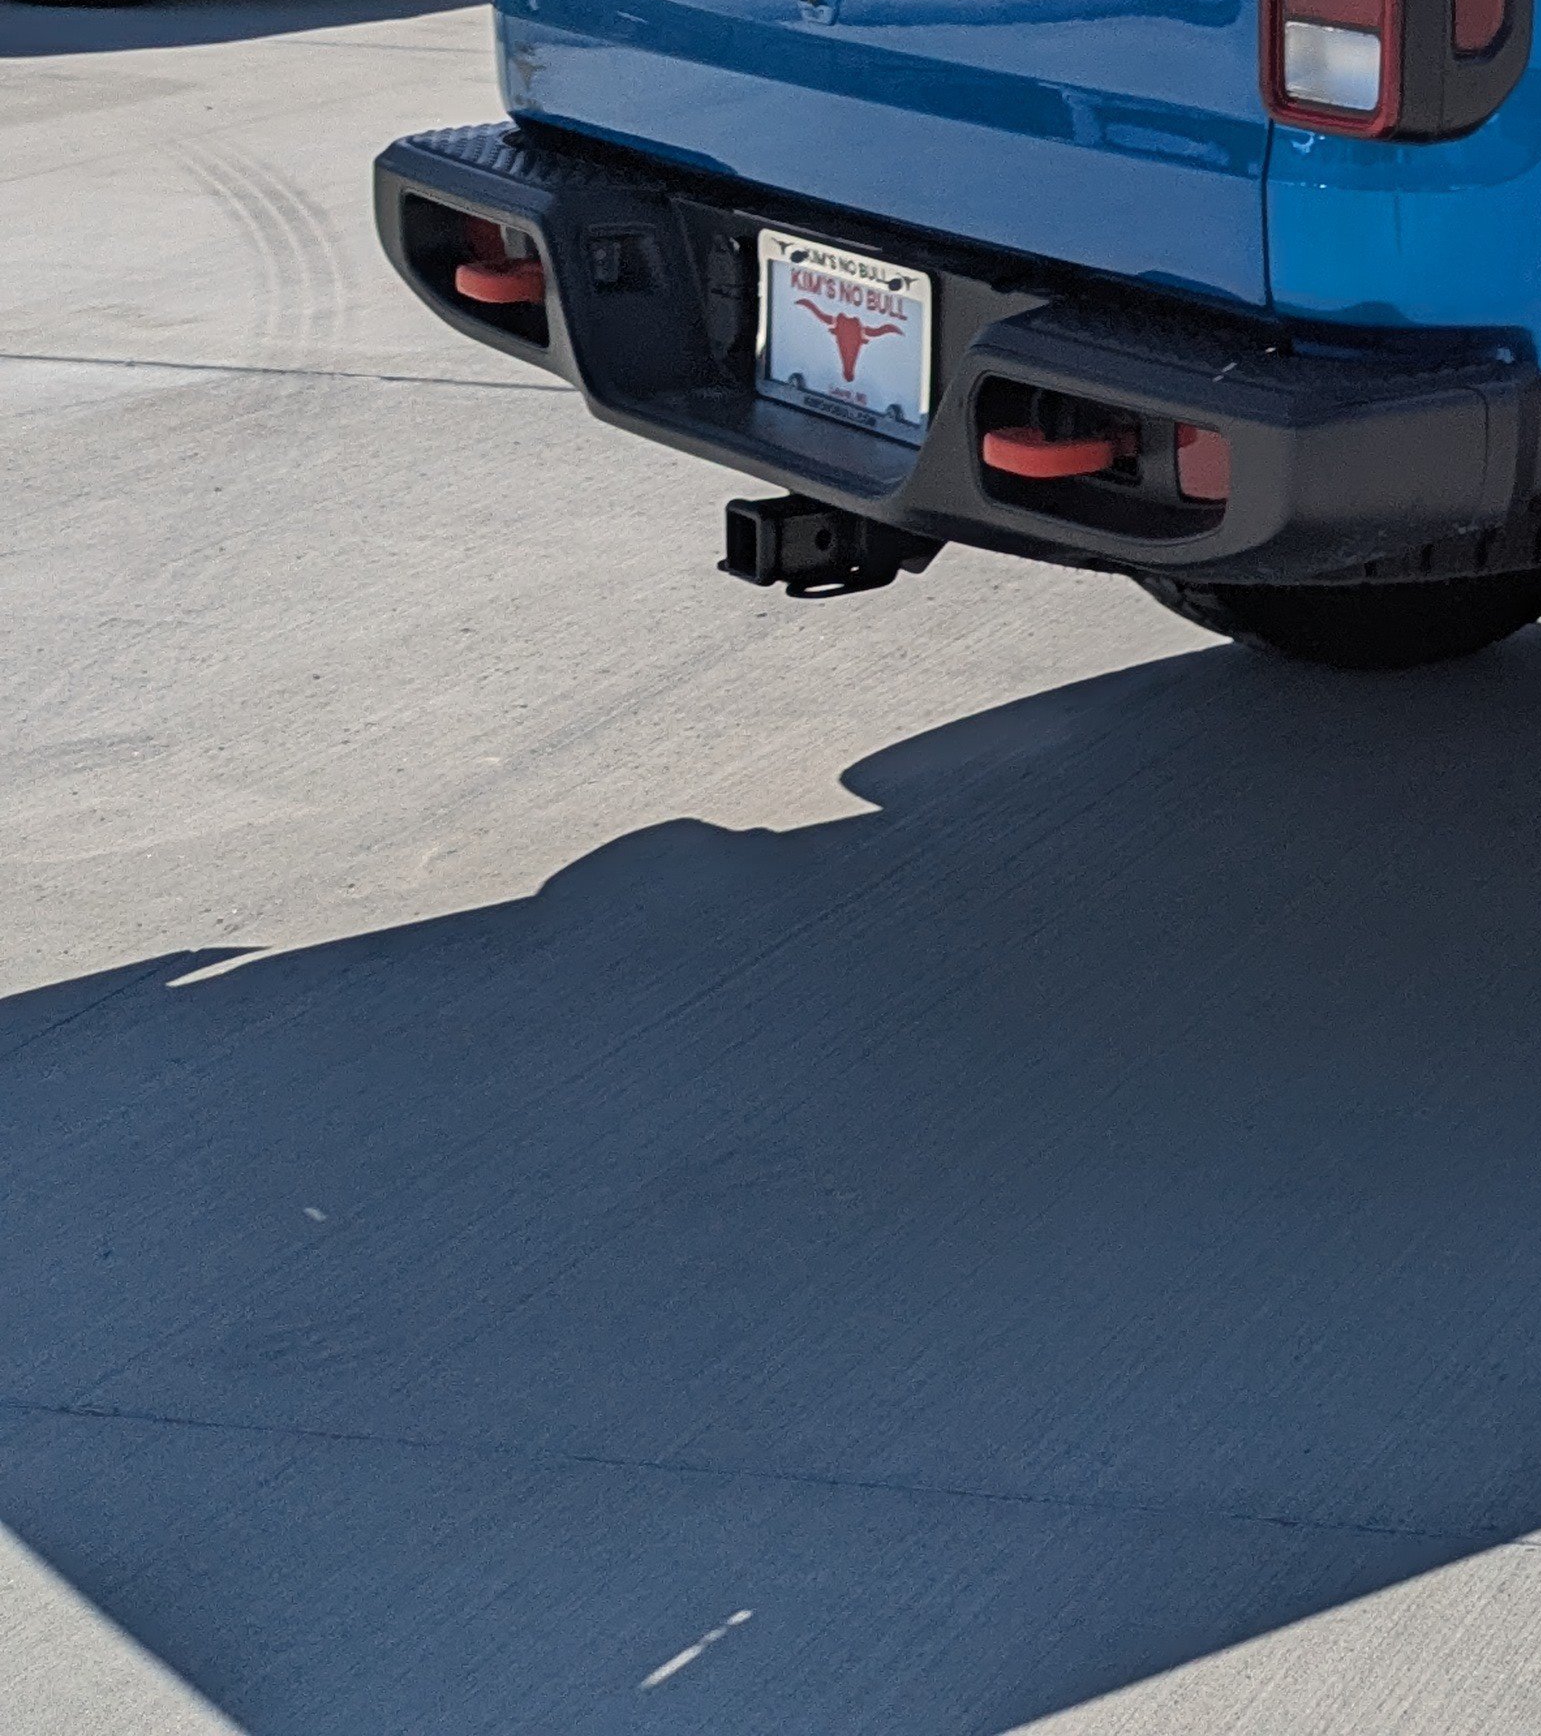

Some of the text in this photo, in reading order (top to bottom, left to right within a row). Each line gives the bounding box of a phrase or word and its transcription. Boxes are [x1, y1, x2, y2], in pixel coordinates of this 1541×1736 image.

[790, 267, 908, 321] KIM'S NO BULL
